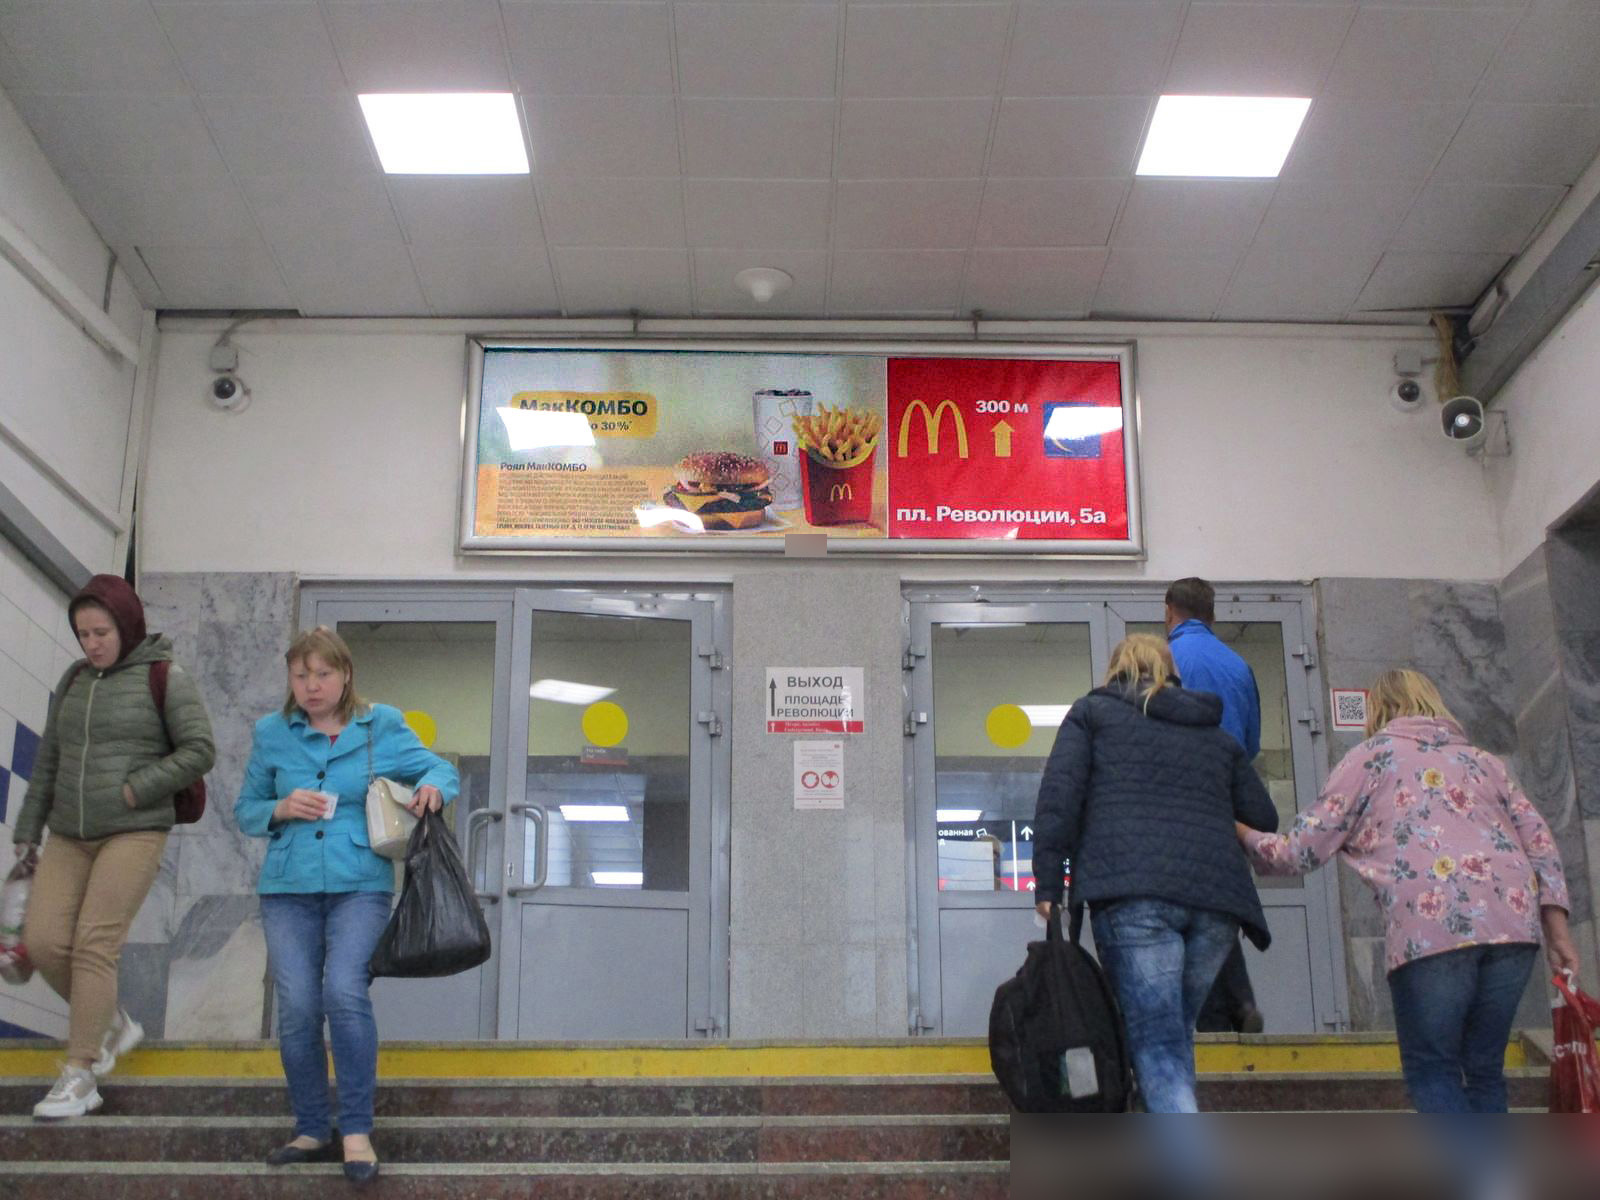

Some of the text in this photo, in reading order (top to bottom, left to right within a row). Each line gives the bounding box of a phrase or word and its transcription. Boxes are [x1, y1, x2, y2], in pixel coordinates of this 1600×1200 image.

[976, 400, 1029, 413] 300 м
[500, 462, 525, 471] Роял
[896, 506, 1106, 526] пл. Революции, 5а
[787, 676, 843, 689] ВЫХОД
